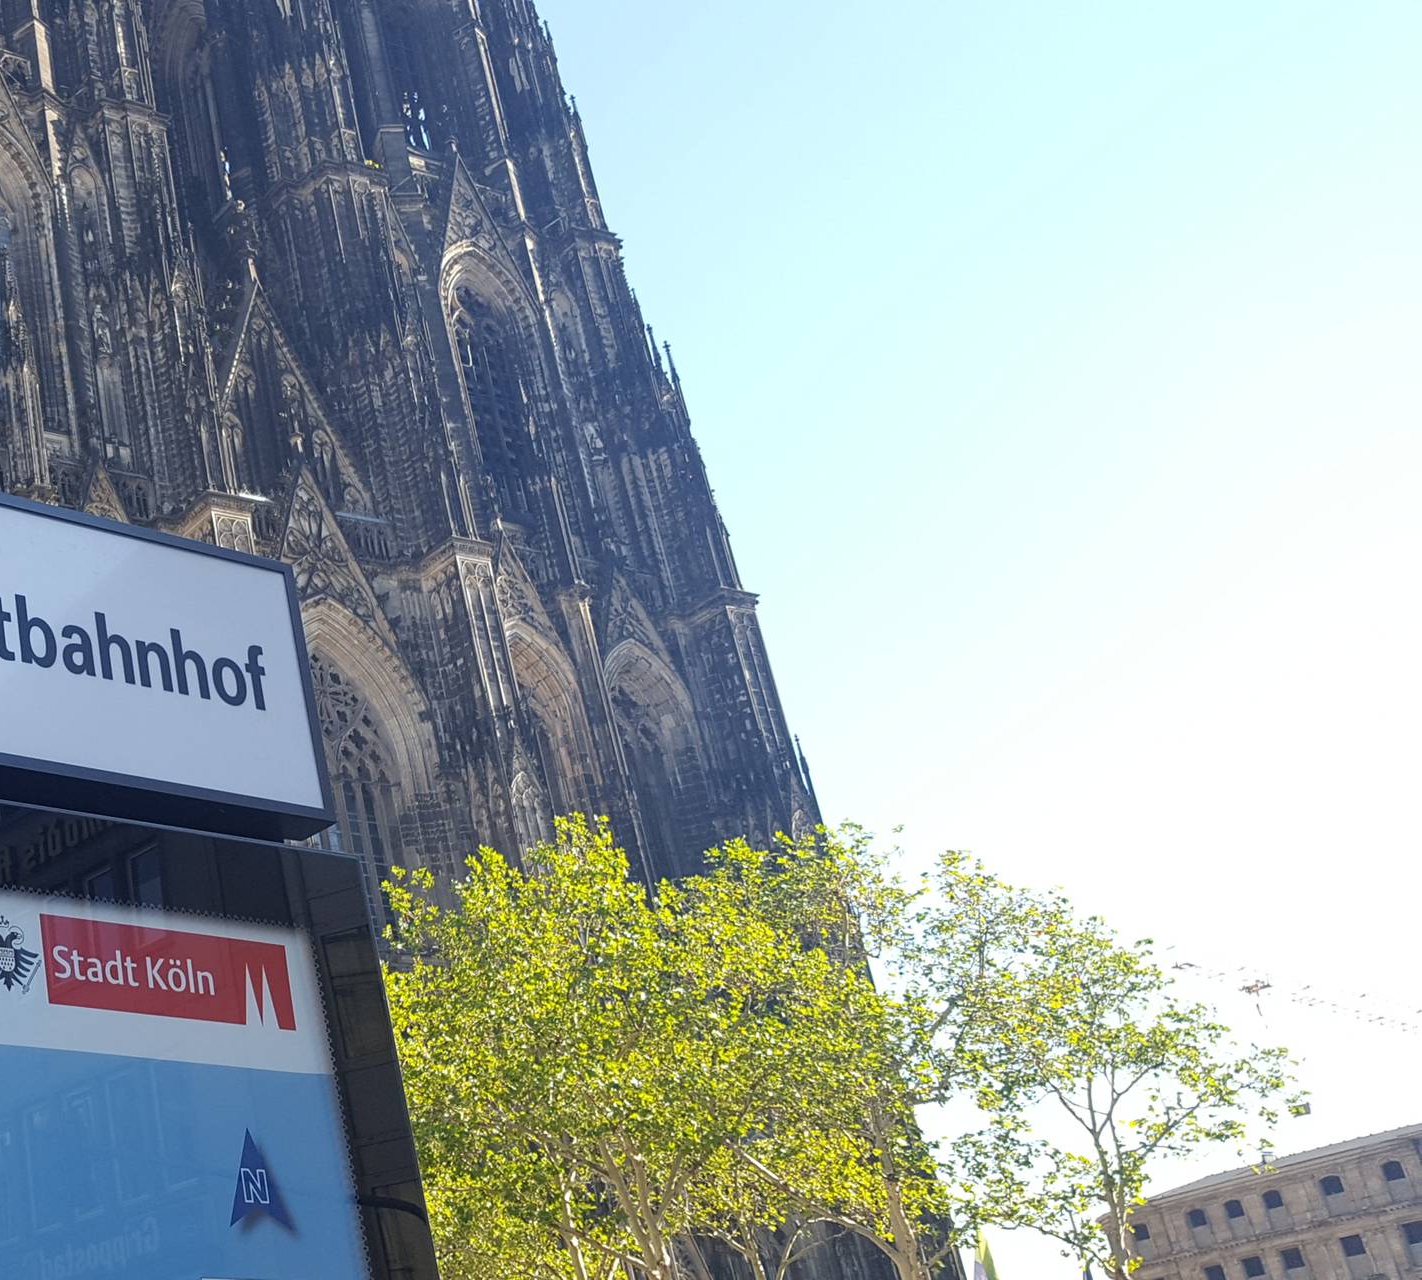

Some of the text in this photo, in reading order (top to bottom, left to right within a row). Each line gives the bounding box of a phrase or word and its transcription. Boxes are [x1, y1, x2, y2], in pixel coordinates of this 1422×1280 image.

[52, 945, 216, 996] Stadt Köln
[240, 1167, 270, 1204] N
